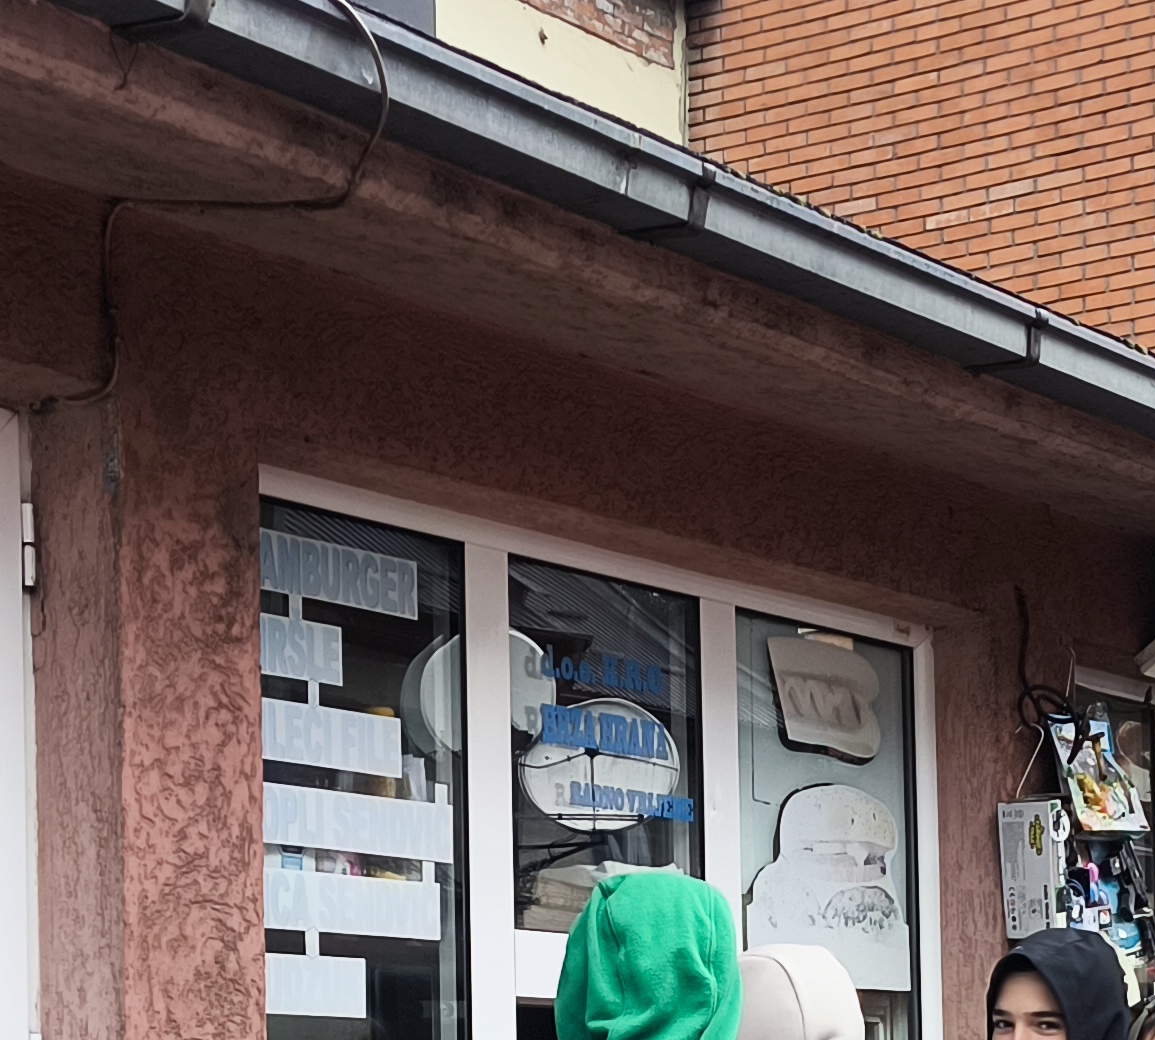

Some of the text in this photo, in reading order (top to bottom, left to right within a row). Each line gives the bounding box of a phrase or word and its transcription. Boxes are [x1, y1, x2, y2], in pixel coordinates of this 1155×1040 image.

[340, 713, 399, 775] FILE
[541, 703, 669, 760] BRZA HRANA
[570, 781, 624, 811] RADNO
